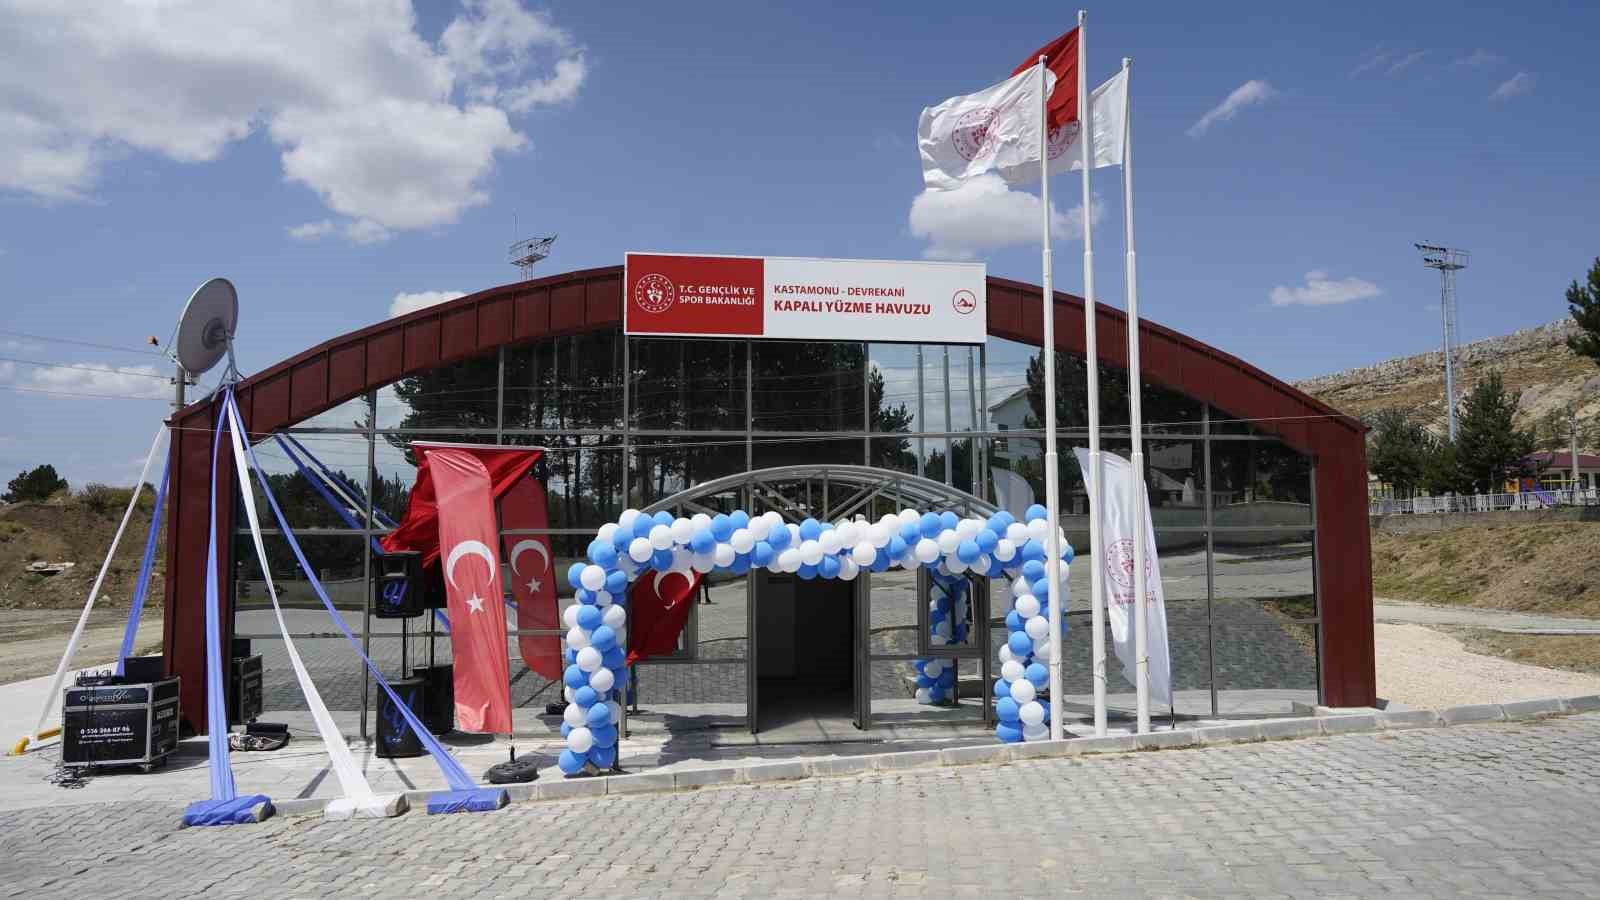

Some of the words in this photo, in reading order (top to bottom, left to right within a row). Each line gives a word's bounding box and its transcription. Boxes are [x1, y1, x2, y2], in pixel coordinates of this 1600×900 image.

[679, 285, 697, 294] T.C.
[698, 285, 742, 297] GENÇLİK
[743, 287, 756, 295] VE
[774, 285, 839, 296] KASTAMONU
[847, 286, 905, 297] DEVREKANİ
[679, 295, 703, 304] SPOR
[705, 296, 756, 305] BAKANLIĞI
[774, 300, 823, 312] KAPALI
[826, 299, 872, 314] YÜZME
[875, 303, 931, 315] HAVUZU
